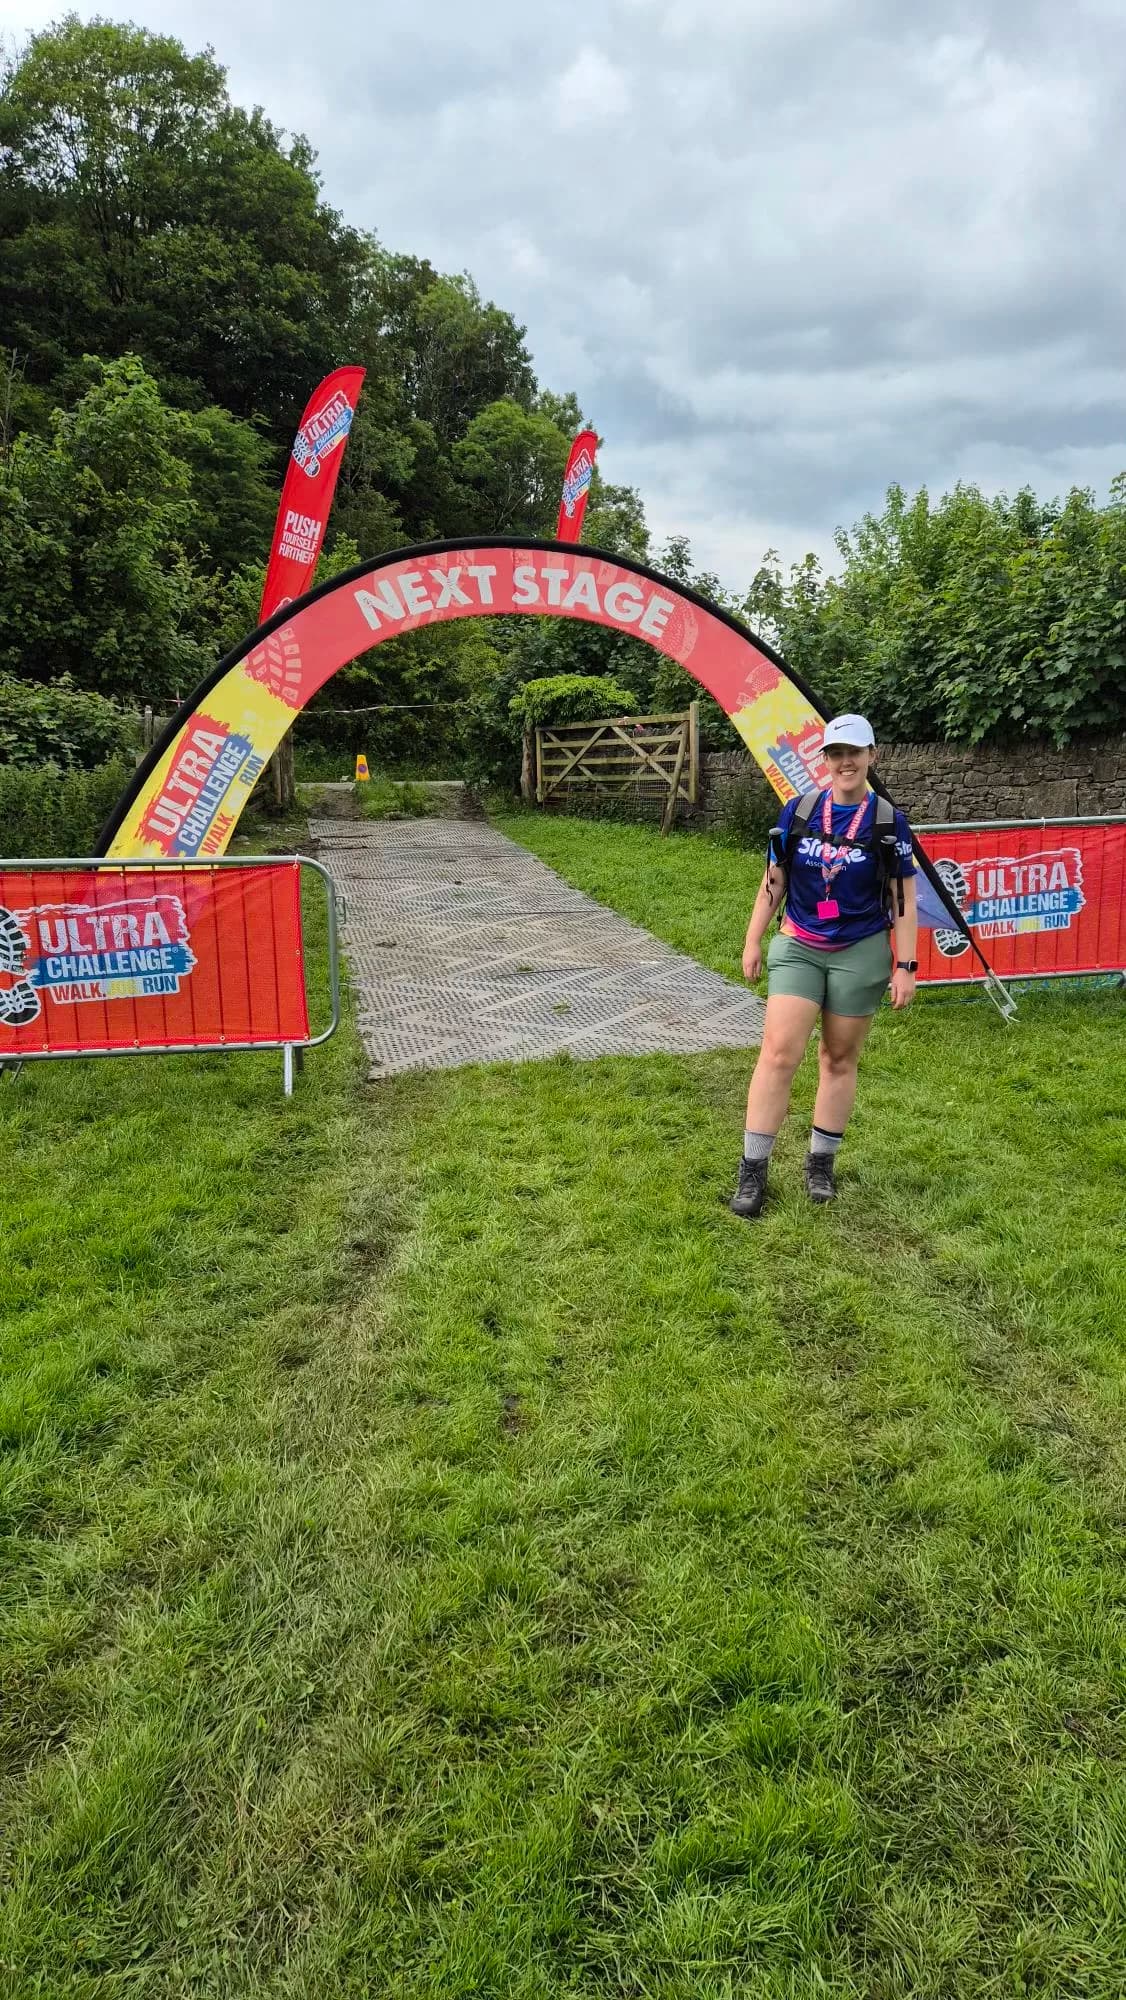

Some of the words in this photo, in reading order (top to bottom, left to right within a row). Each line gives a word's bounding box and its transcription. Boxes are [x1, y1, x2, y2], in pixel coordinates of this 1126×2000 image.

[308, 400, 345, 440] ULTRA
[282, 530, 318, 552] YOURSELF
[284, 510, 322, 541] PUSH
[278, 543, 315, 565] FURTHER
[354, 565, 496, 630] NEXT
[512, 566, 675, 638] STAGE
[148, 729, 227, 836] ULTRA
[239, 754, 264, 786] RUN
[178, 742, 246, 847] CHALLENGE
[977, 862, 1069, 898] ULTRA
[978, 891, 1069, 919] CHALLENGE
[1044, 913, 1069, 928] RUN
[38, 912, 171, 954] ULTRA
[46, 948, 174, 979] CHALLENGE
[142, 974, 177, 993] RUN
